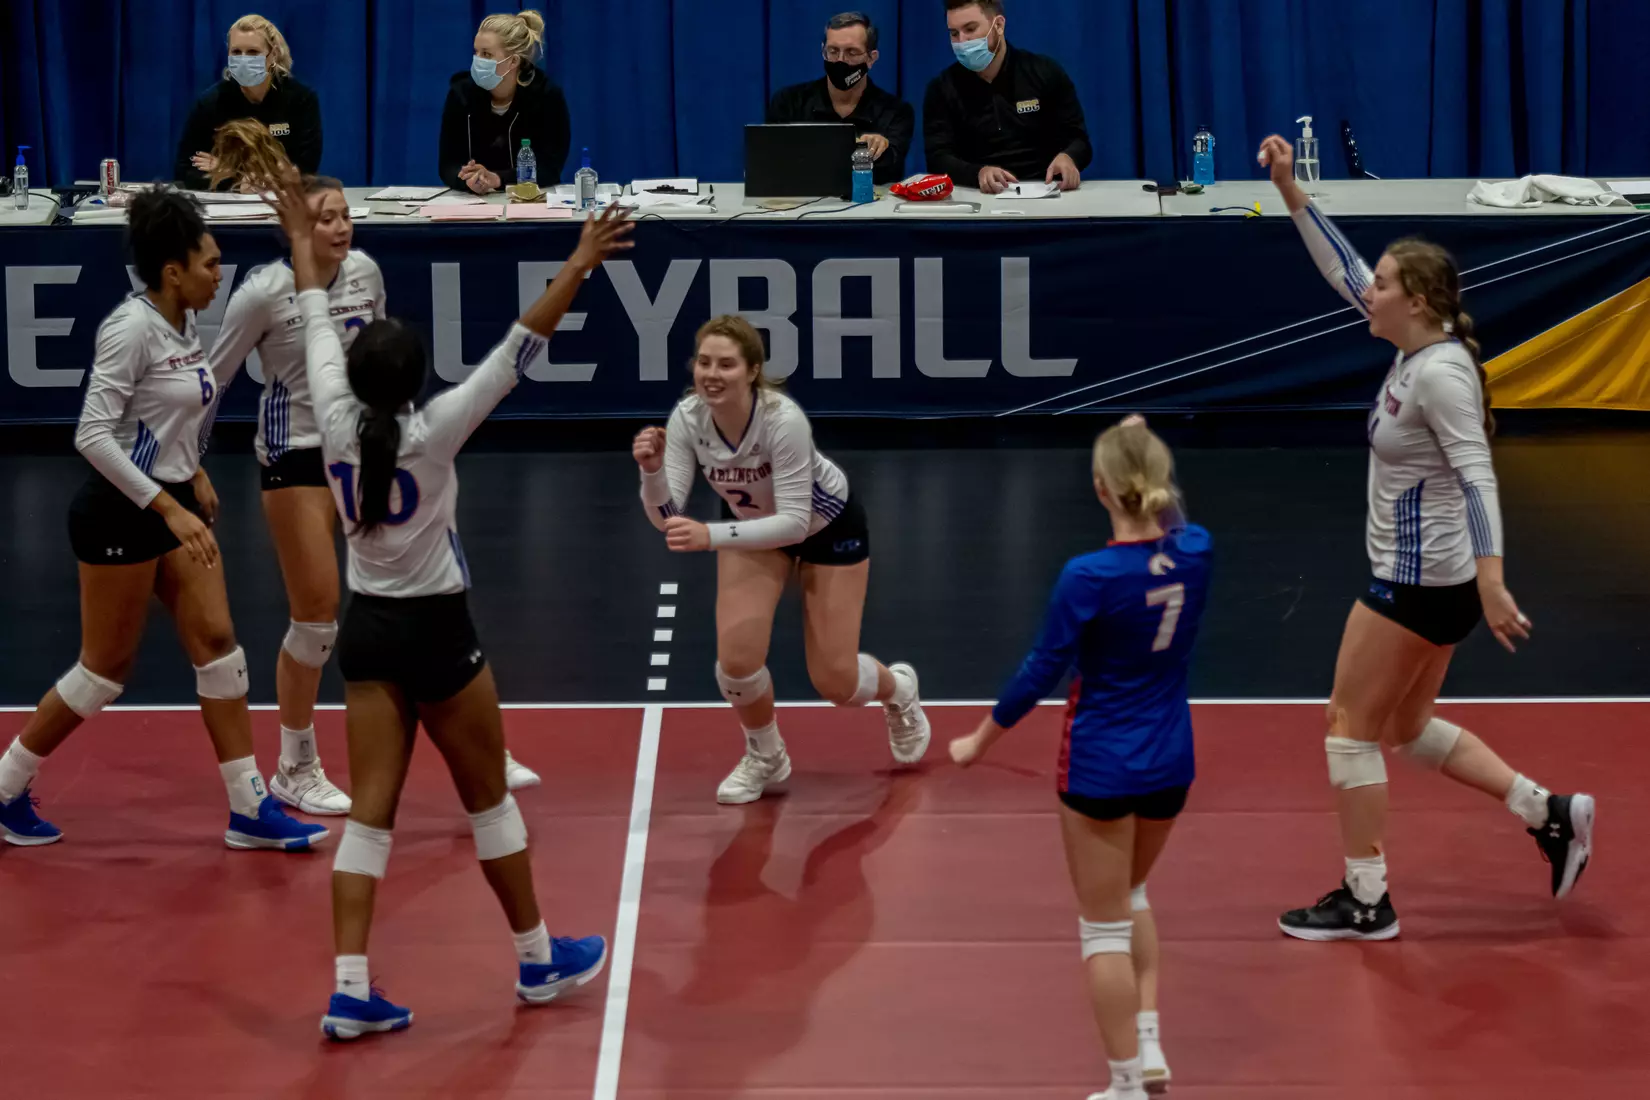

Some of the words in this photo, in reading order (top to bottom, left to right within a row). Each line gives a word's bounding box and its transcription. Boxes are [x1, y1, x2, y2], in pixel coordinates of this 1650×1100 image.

[198, 367, 214, 406] 6
[726, 489, 760, 510] 2
[1146, 582, 1185, 652] 7
